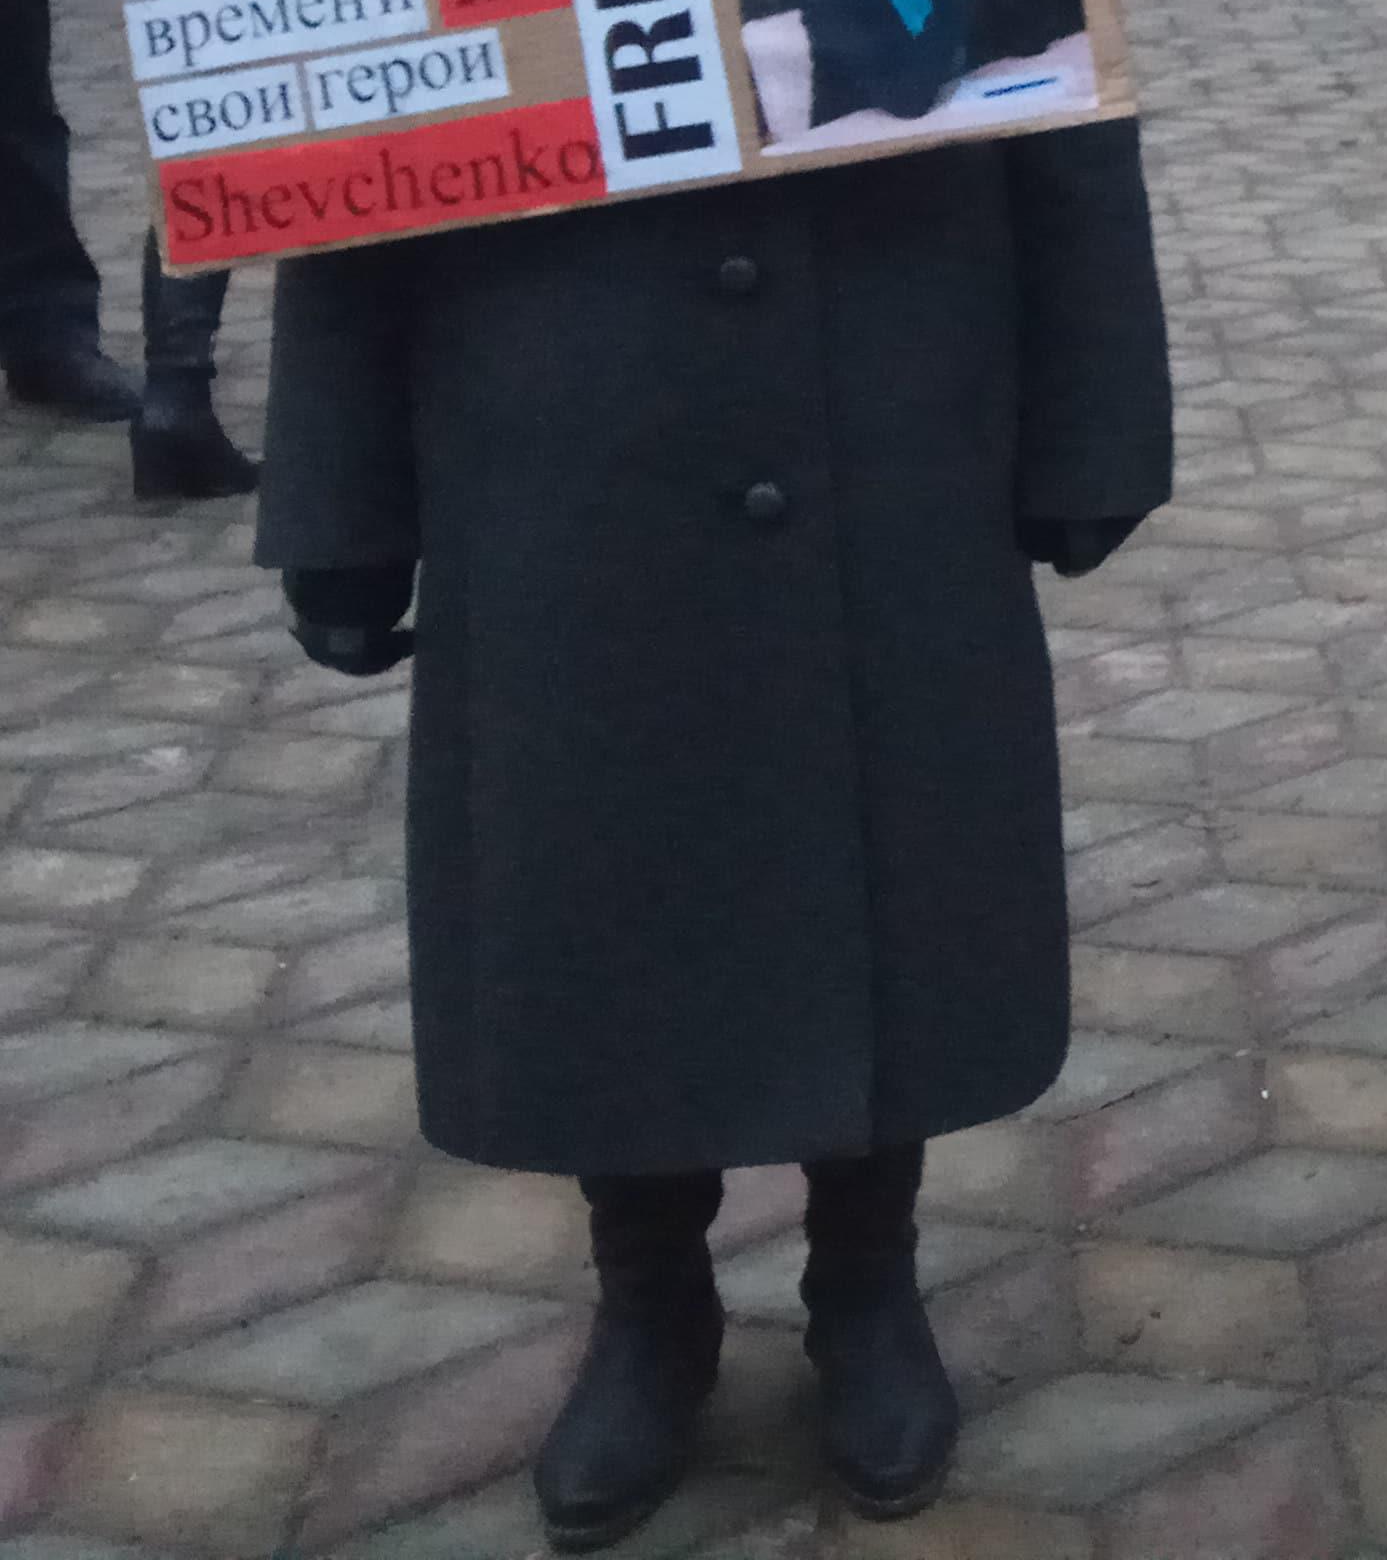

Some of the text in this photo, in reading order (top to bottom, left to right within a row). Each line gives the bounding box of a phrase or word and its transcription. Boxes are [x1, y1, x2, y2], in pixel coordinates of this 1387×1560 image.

[151, 42, 498, 143] свои герои
[169, 128, 600, 244] Shevchenko
